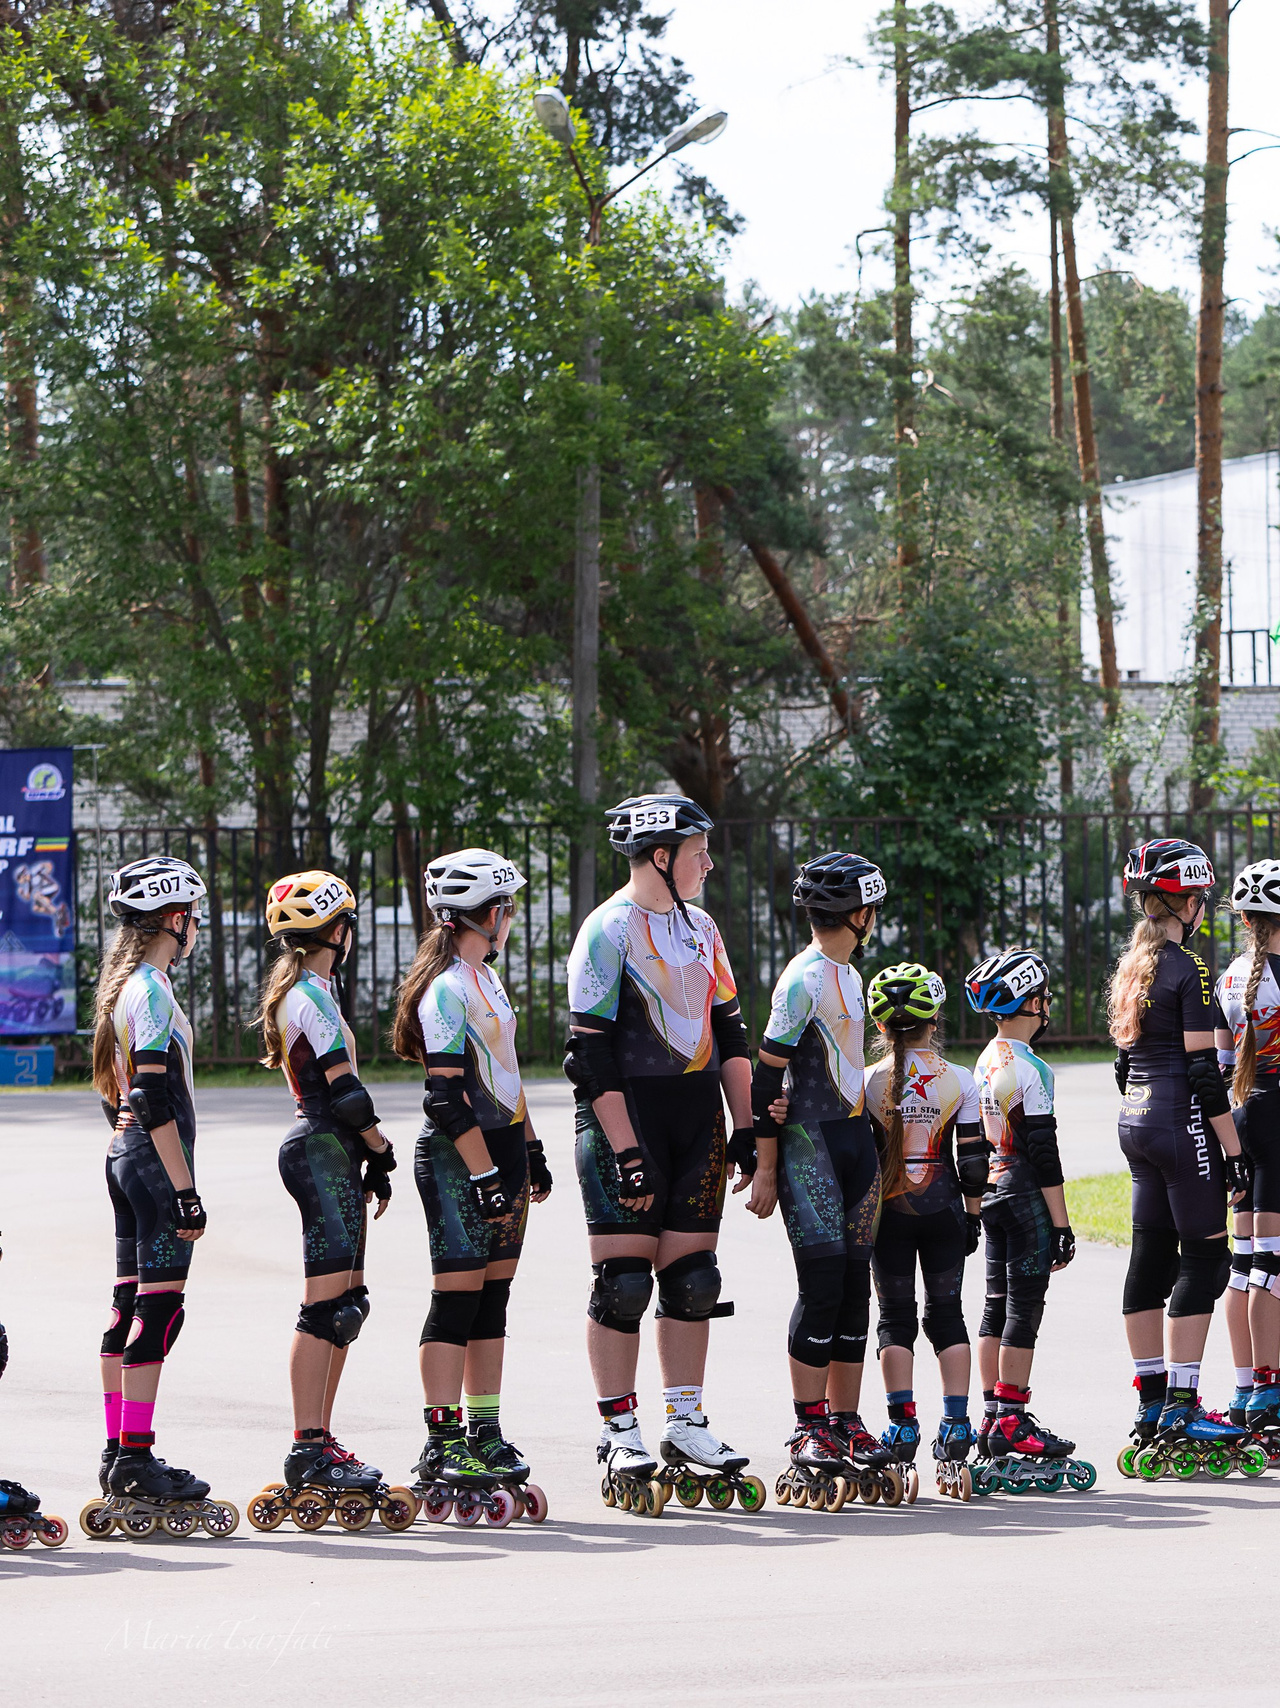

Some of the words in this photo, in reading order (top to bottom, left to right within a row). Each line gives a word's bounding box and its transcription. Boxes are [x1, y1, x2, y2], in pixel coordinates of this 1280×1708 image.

[634, 810, 671, 827] 553
[492, 867, 515, 886] 525
[1184, 864, 1208, 880] 404
[147, 876, 181, 898] 507
[314, 883, 343, 911] 512
[1011, 964, 1038, 992] 257
[931, 980, 946, 998] 30
[15, 1052, 38, 1087] 2
[886, 1105, 917, 1117] ROLER
[921, 1106, 941, 1115] STAR
